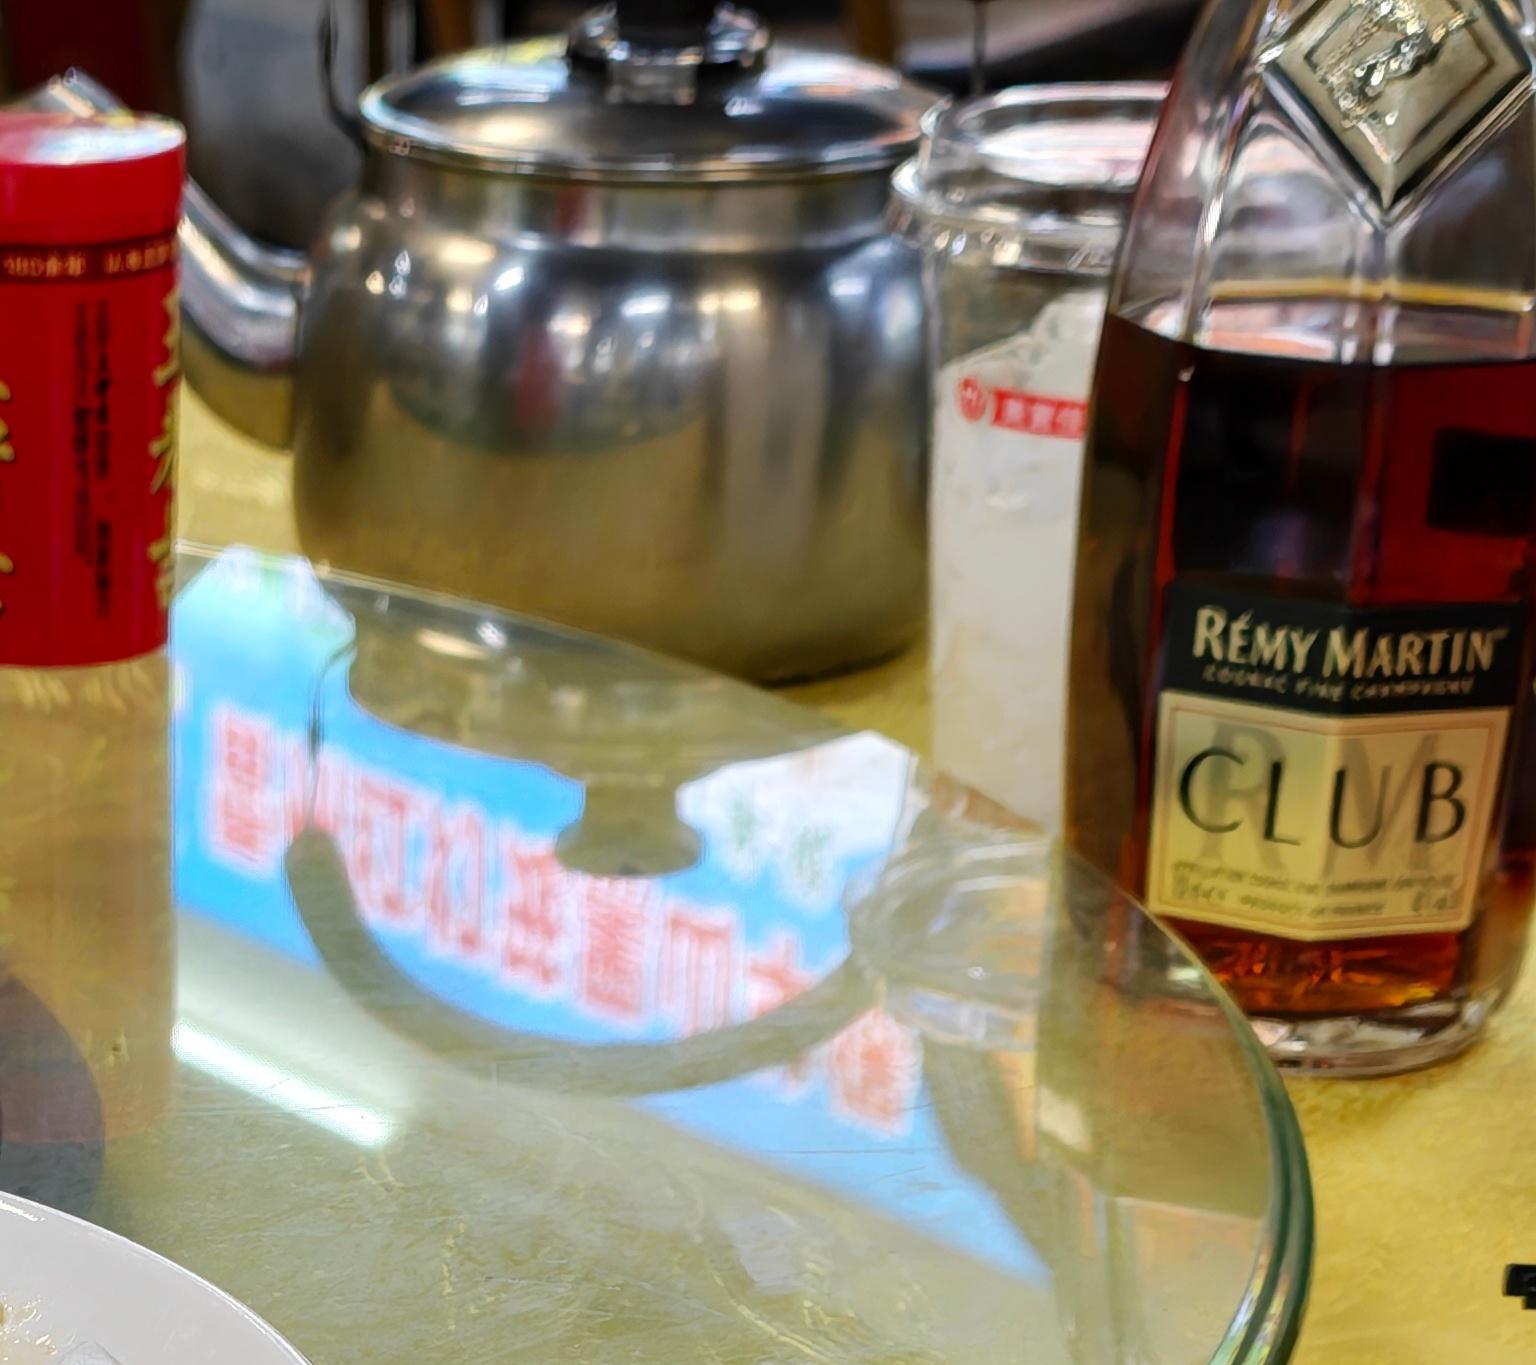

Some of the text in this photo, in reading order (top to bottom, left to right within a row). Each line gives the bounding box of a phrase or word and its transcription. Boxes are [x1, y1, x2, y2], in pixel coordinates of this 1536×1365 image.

[1192, 603, 1509, 679] RÉMY MARTIN
[1179, 747, 1466, 849] CLUB
